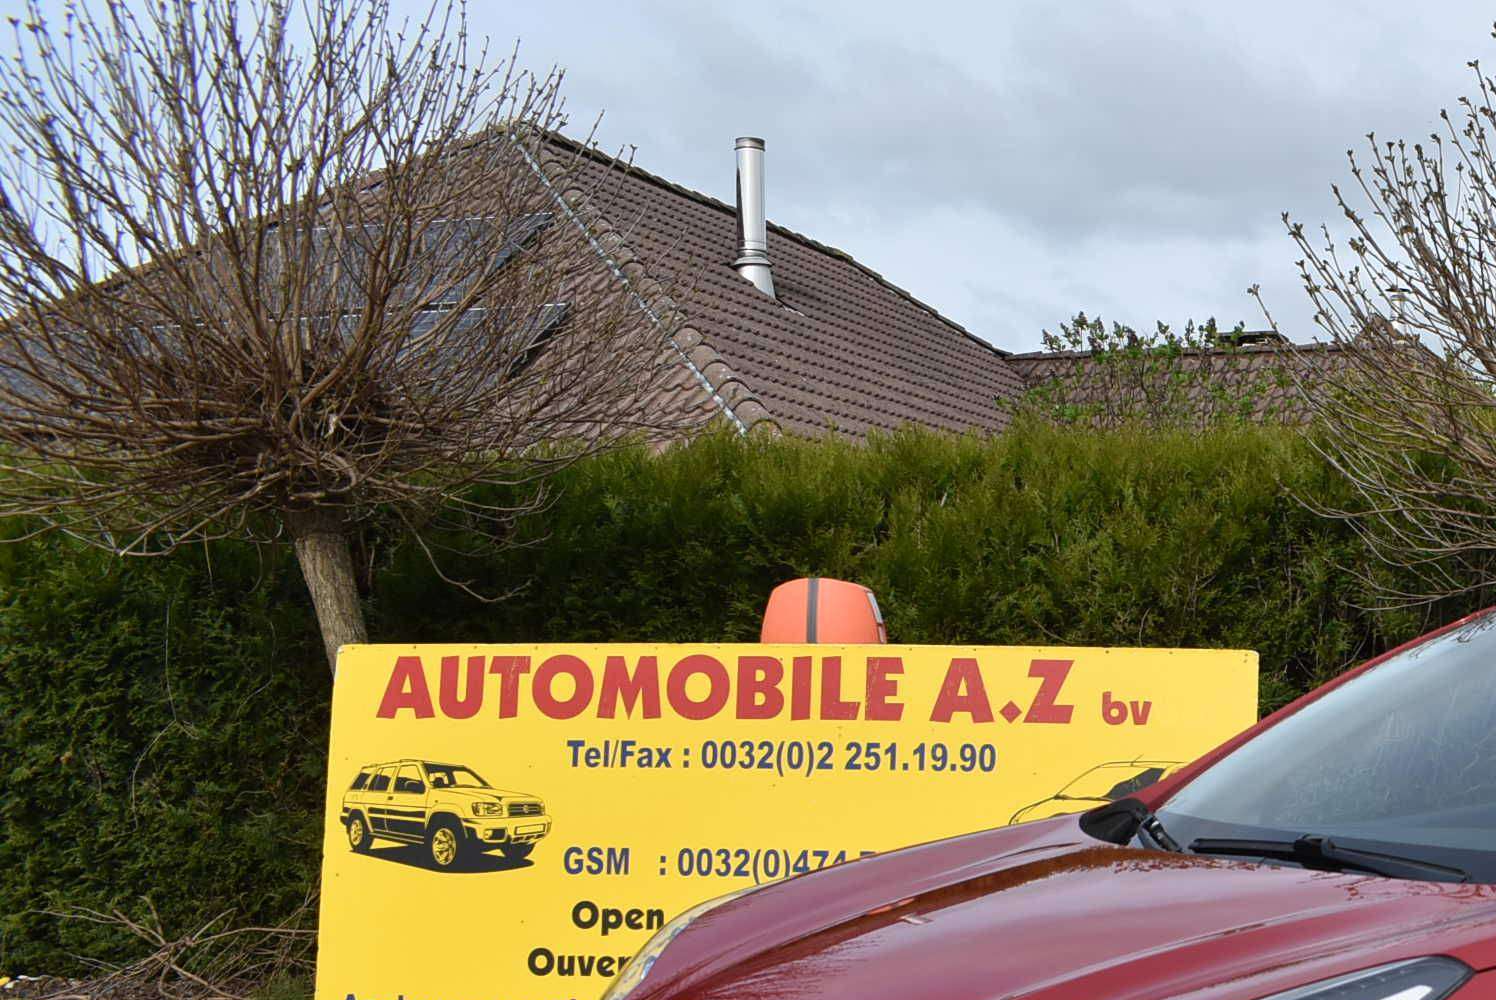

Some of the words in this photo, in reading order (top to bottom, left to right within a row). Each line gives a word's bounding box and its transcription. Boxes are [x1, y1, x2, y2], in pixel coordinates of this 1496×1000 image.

[375, 654, 905, 721] AUTOMOBILE
[929, 657, 1075, 725] A.Z
[1101, 691, 1153, 726] bv
[566, 739, 672, 770] Tel/Fax
[701, 740, 834, 777] 0032(0)2
[844, 741, 996, 773] 251.19.90
[563, 846, 630, 876] GSM
[571, 900, 665, 936] Open
